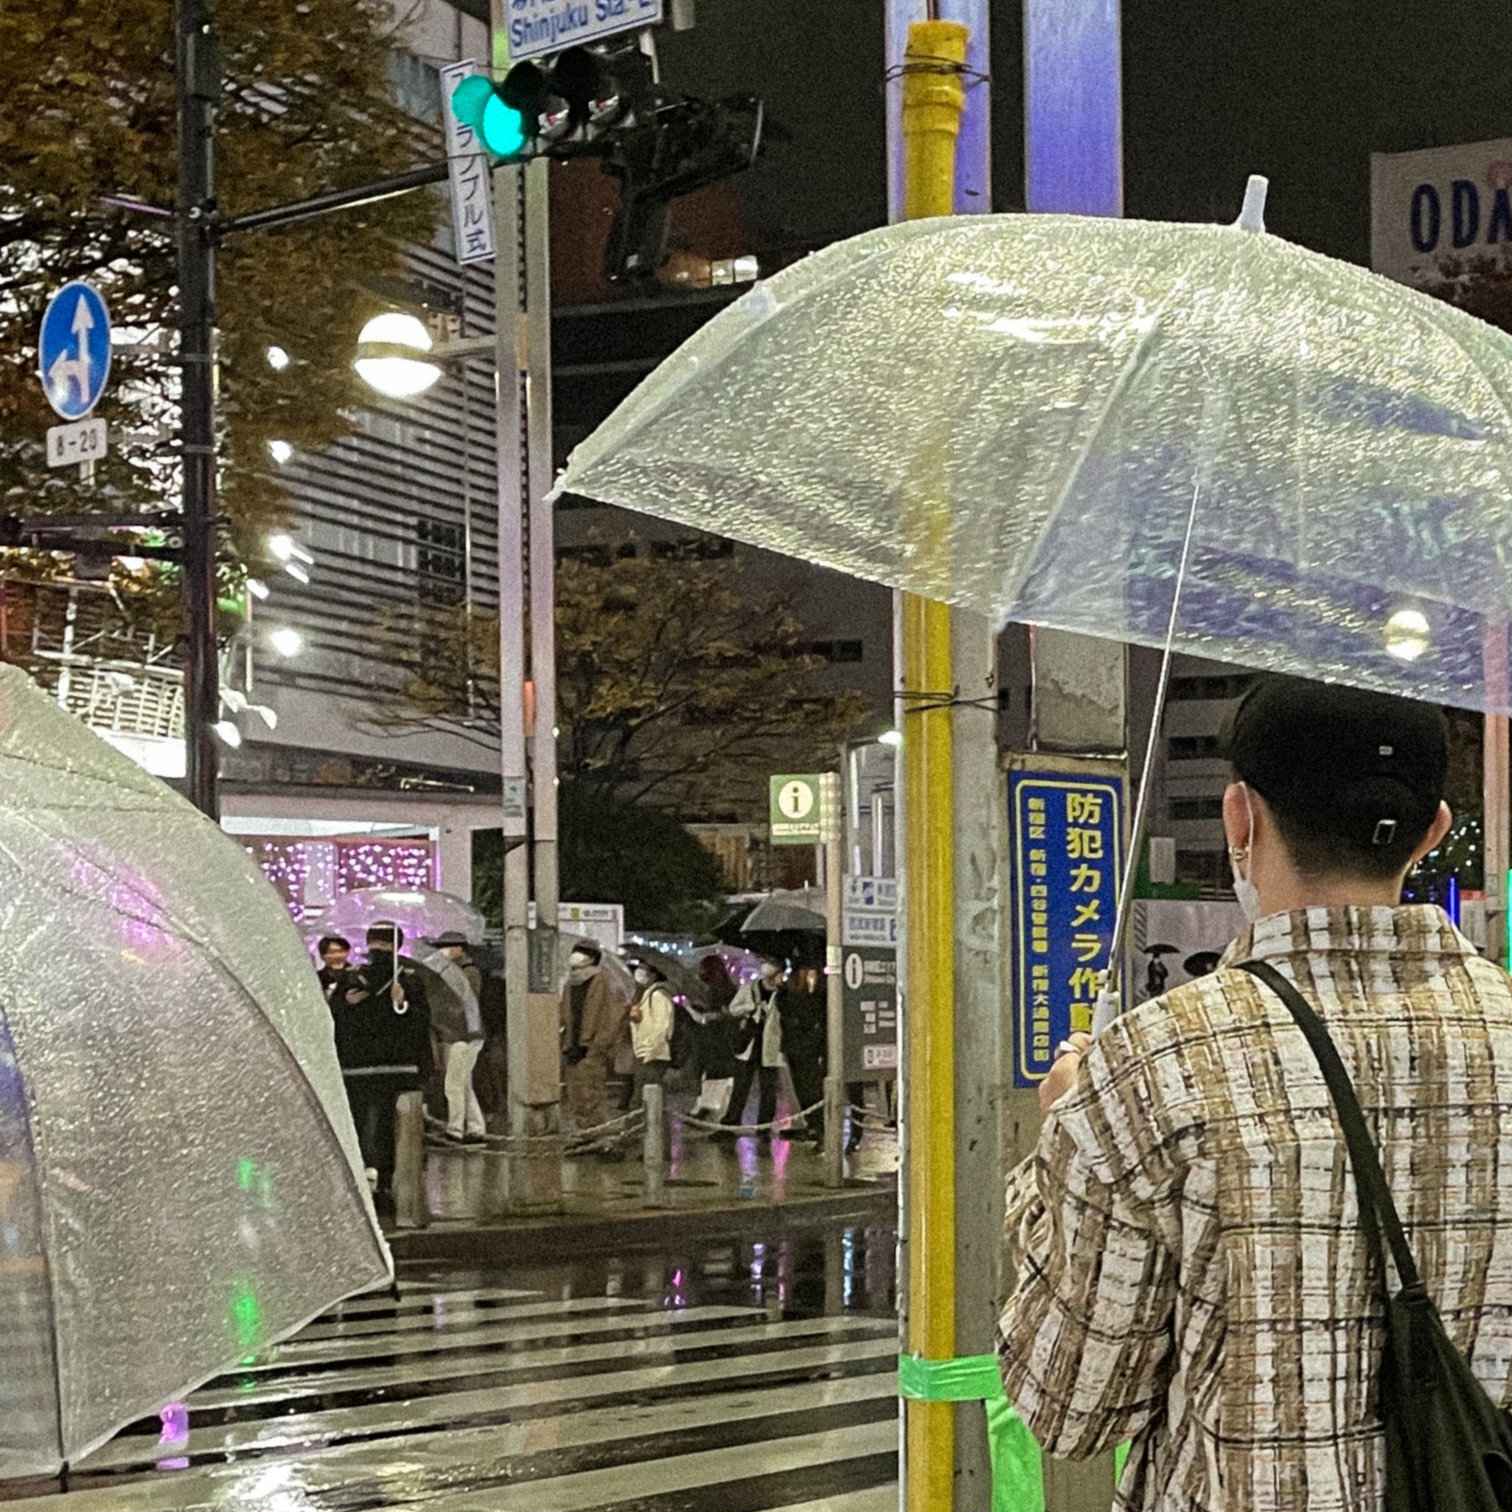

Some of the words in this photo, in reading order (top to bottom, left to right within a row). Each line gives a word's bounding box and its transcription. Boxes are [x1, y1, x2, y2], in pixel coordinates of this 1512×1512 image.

[511, 3, 589, 47] Shinjuku
[451, 70, 488, 254] ランブル式
